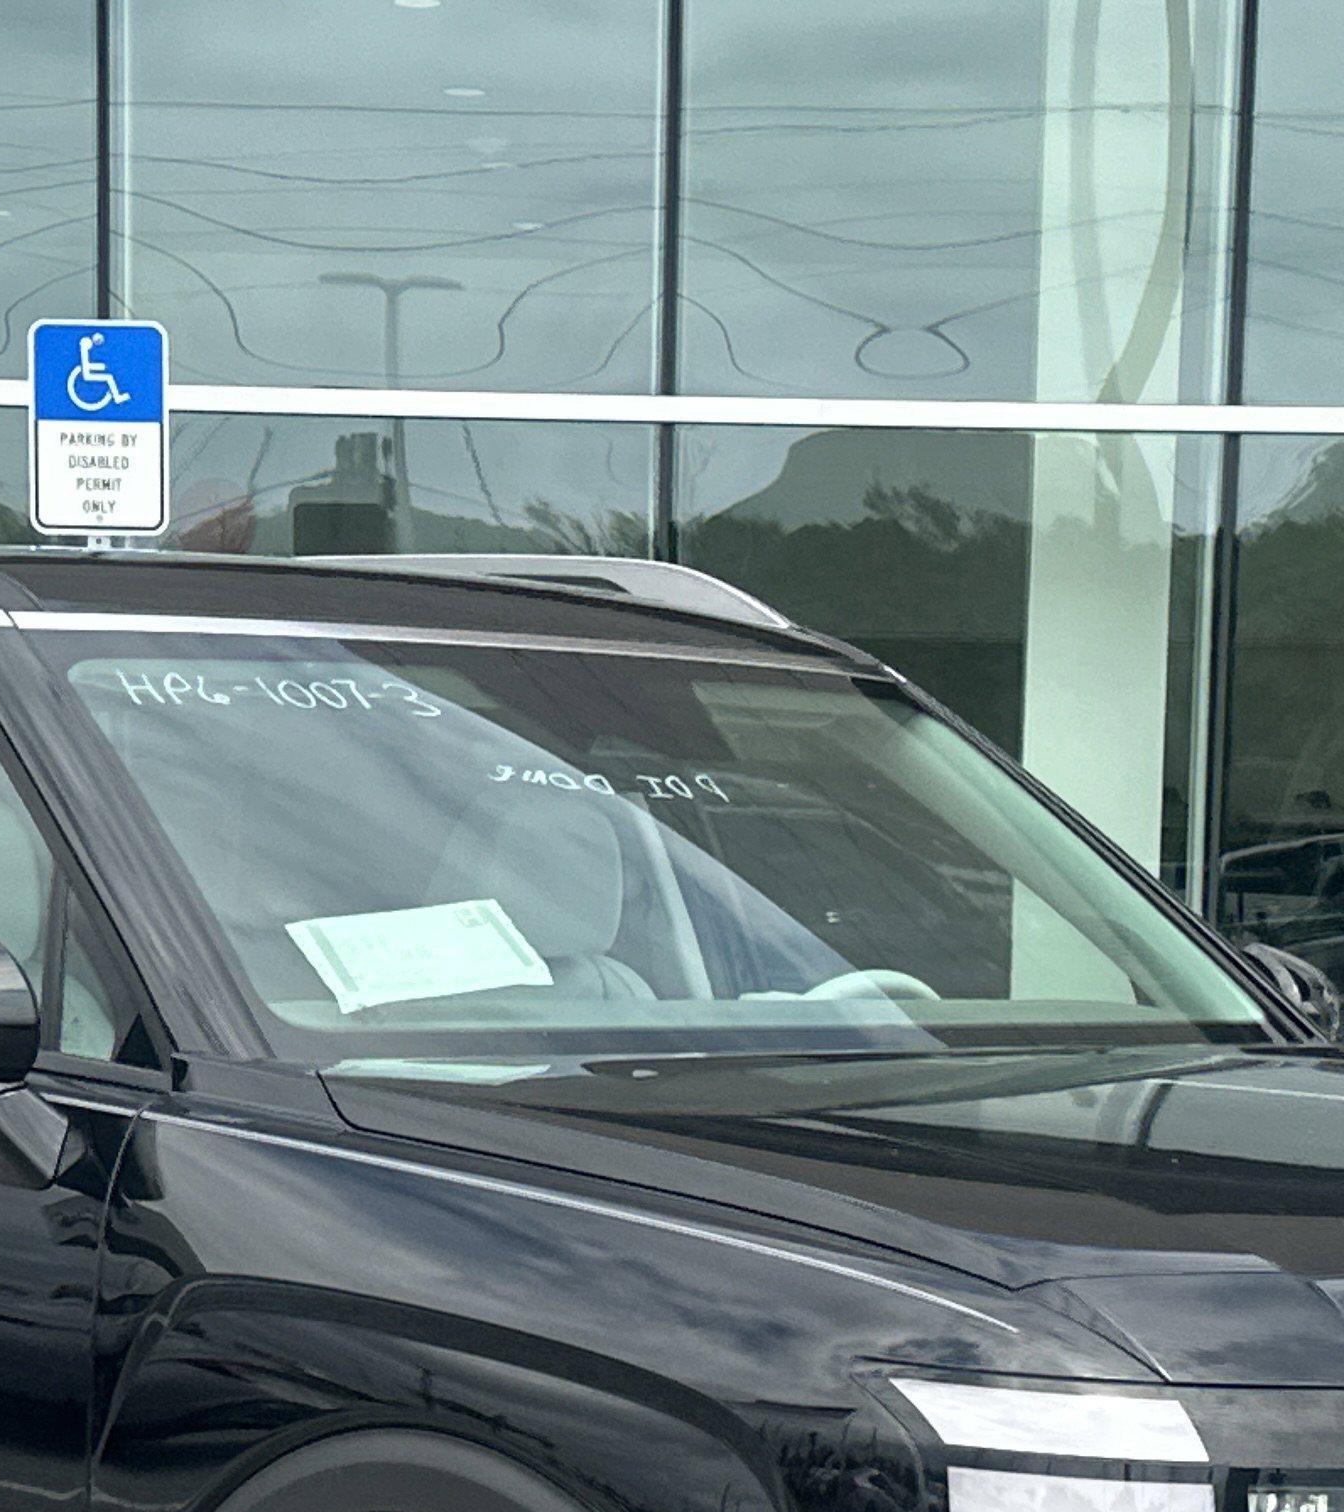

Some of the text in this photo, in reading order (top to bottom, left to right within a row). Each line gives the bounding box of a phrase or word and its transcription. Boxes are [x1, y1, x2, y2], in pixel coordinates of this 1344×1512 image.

[60, 432, 137, 448] PARKING BY
[68, 455, 129, 470] DISABLED
[76, 477, 122, 492] PERMIT
[82, 499, 116, 514] ONLY
